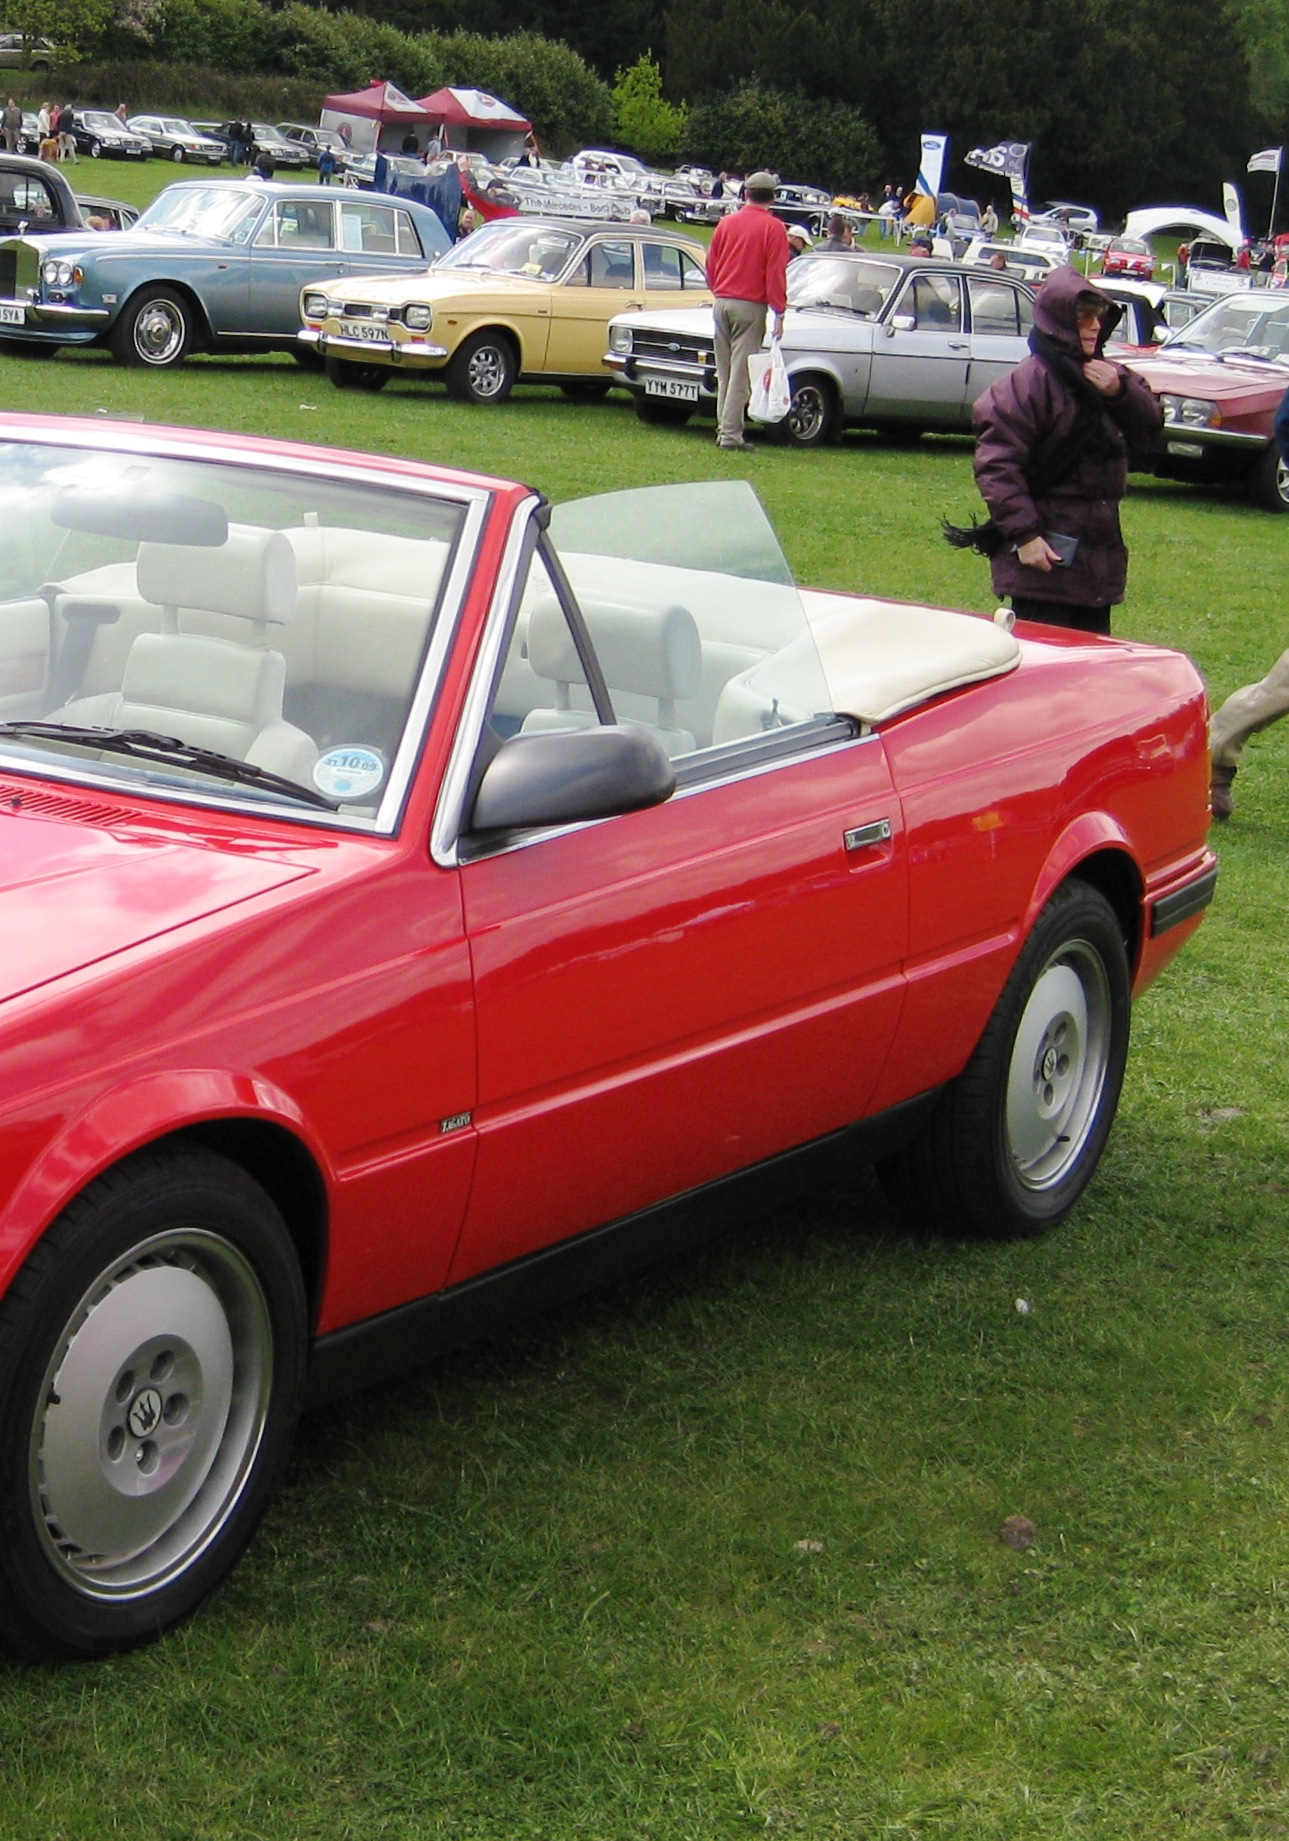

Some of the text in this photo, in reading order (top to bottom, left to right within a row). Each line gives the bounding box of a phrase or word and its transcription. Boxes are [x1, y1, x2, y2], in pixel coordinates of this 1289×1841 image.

[2, 309, 20, 321] SYA
[340, 324, 389, 340] HLC 597N
[647, 379, 696, 398] YYM 577T
[340, 756, 361, 769] 10
